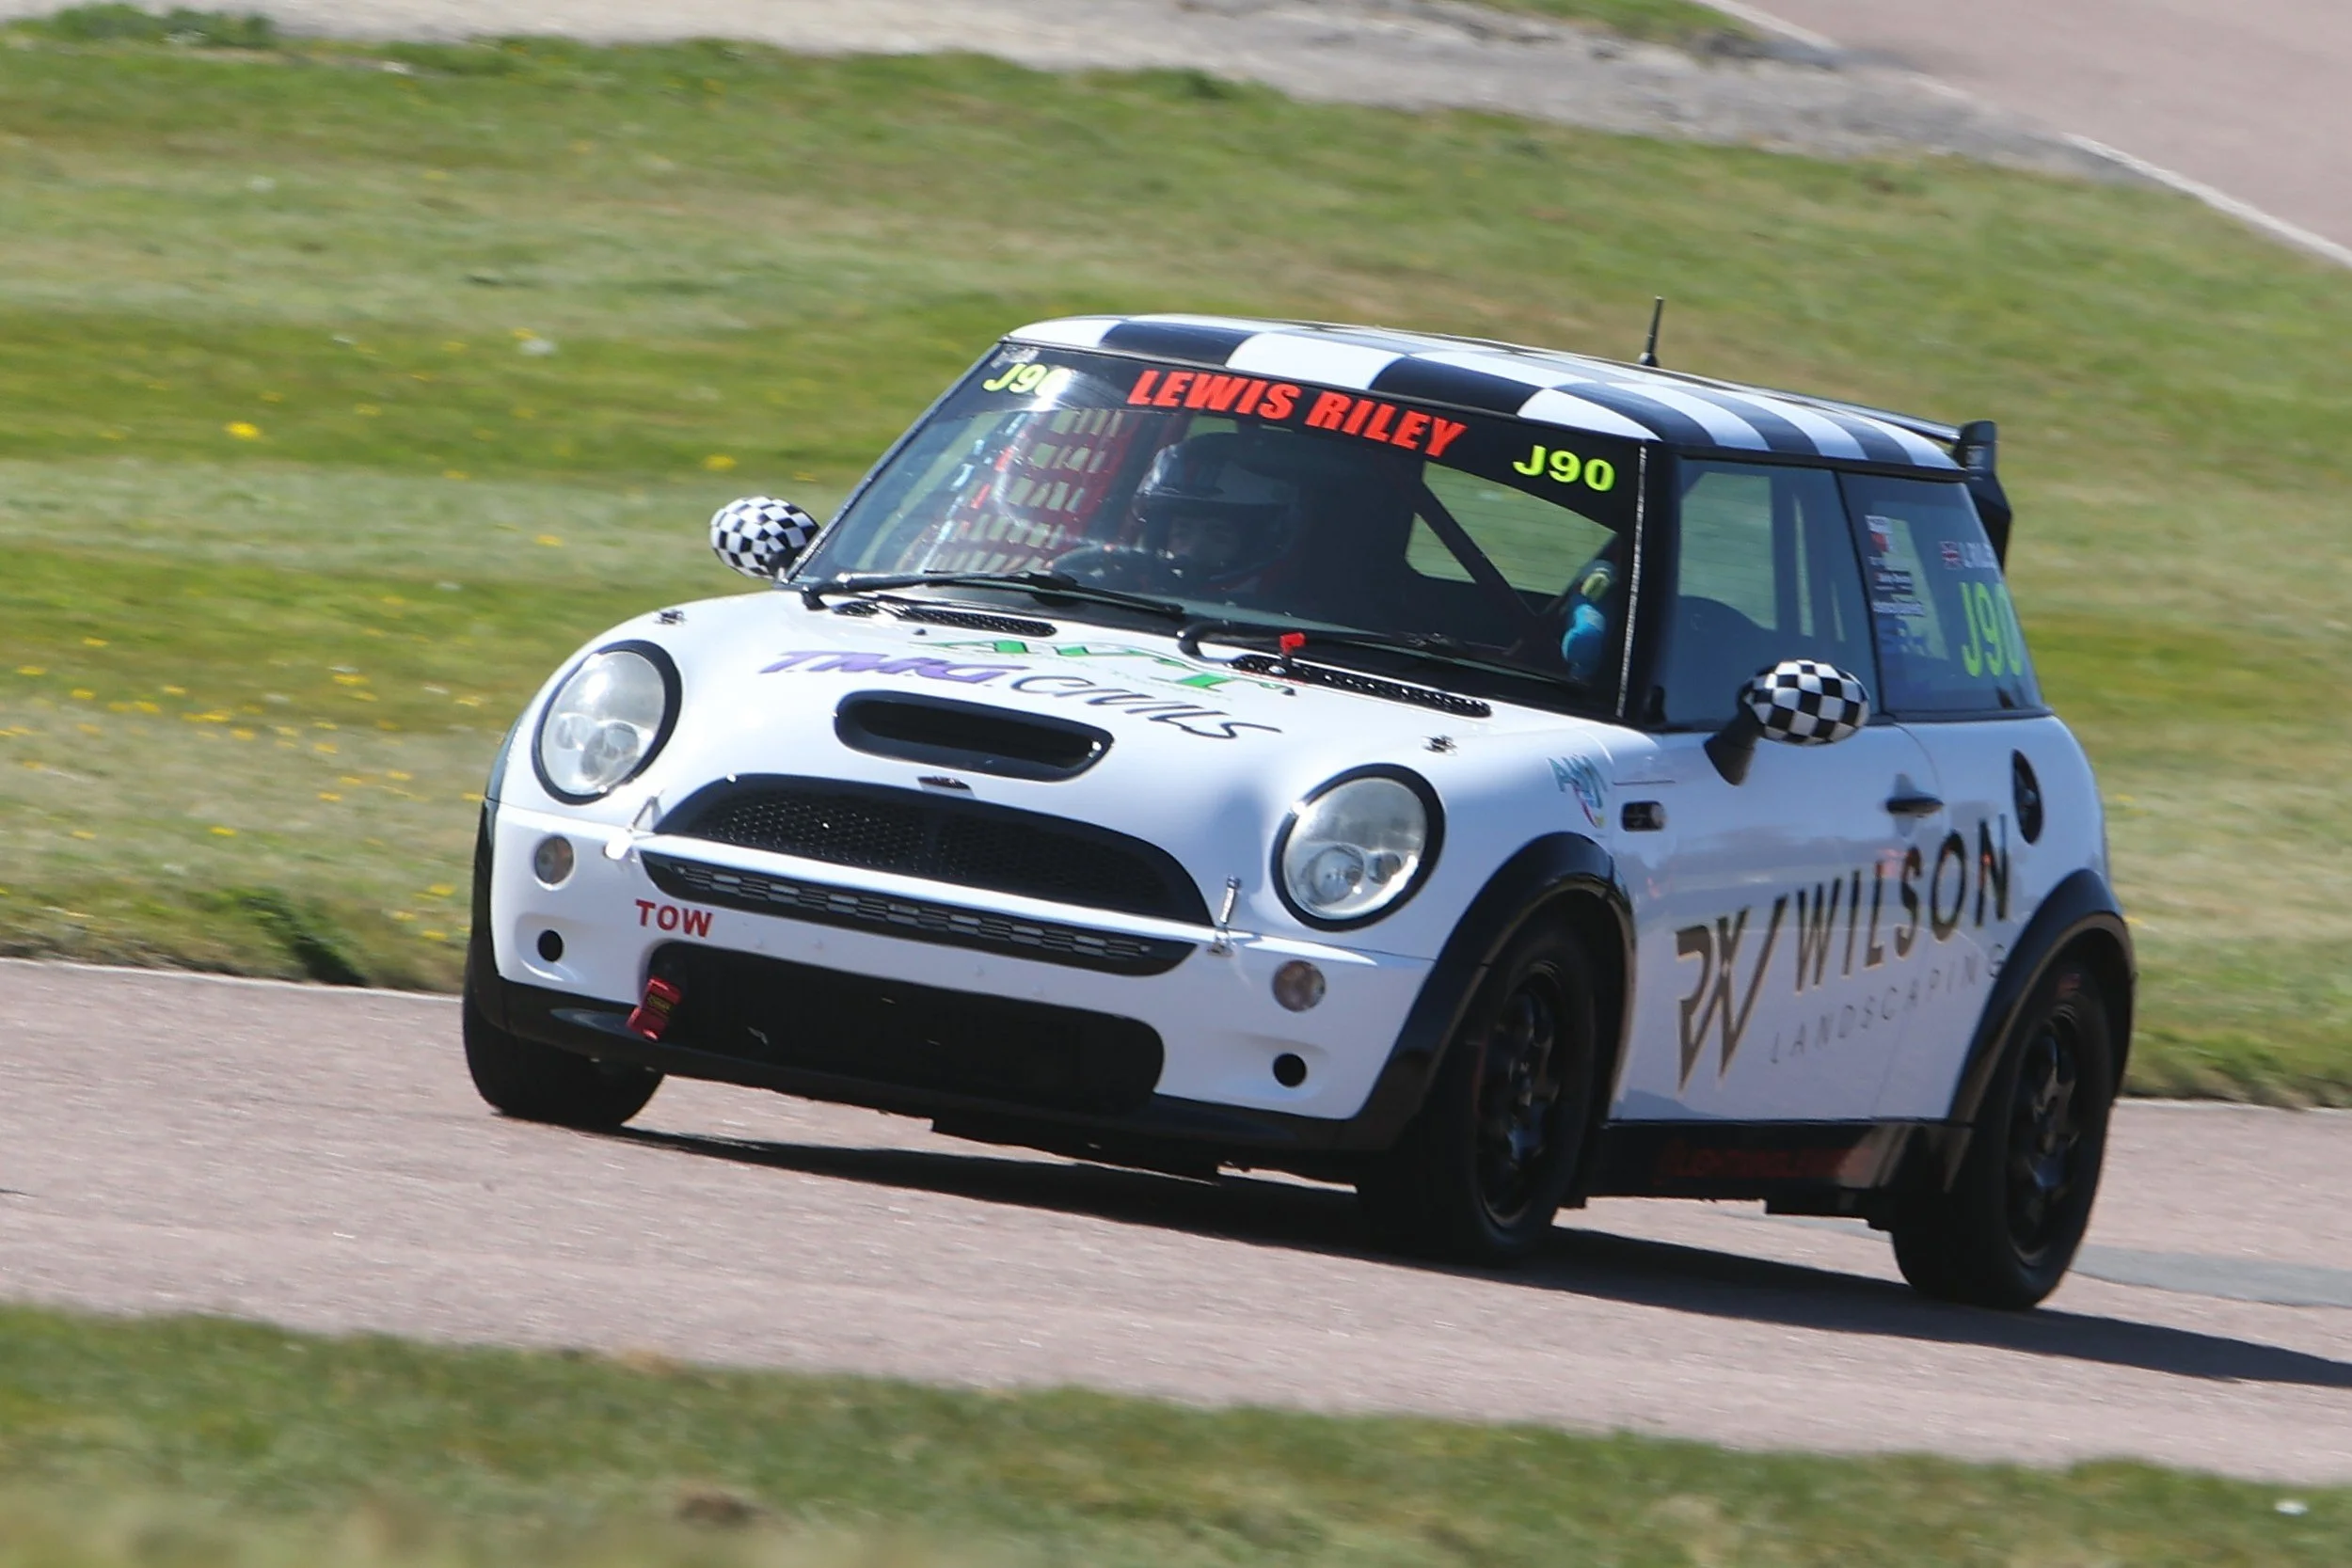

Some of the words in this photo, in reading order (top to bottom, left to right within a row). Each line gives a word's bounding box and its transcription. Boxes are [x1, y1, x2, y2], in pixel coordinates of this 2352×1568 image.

[1127, 369, 1302, 421] LEWIS
[1303, 389, 1467, 458] RILEY
[1513, 445, 1616, 493] J90
[1960, 582, 2023, 678] J90
[635, 899, 714, 938] TOW
[1794, 814, 2011, 995] WILSON
[1771, 942, 2007, 1064] LANDSCAPING
